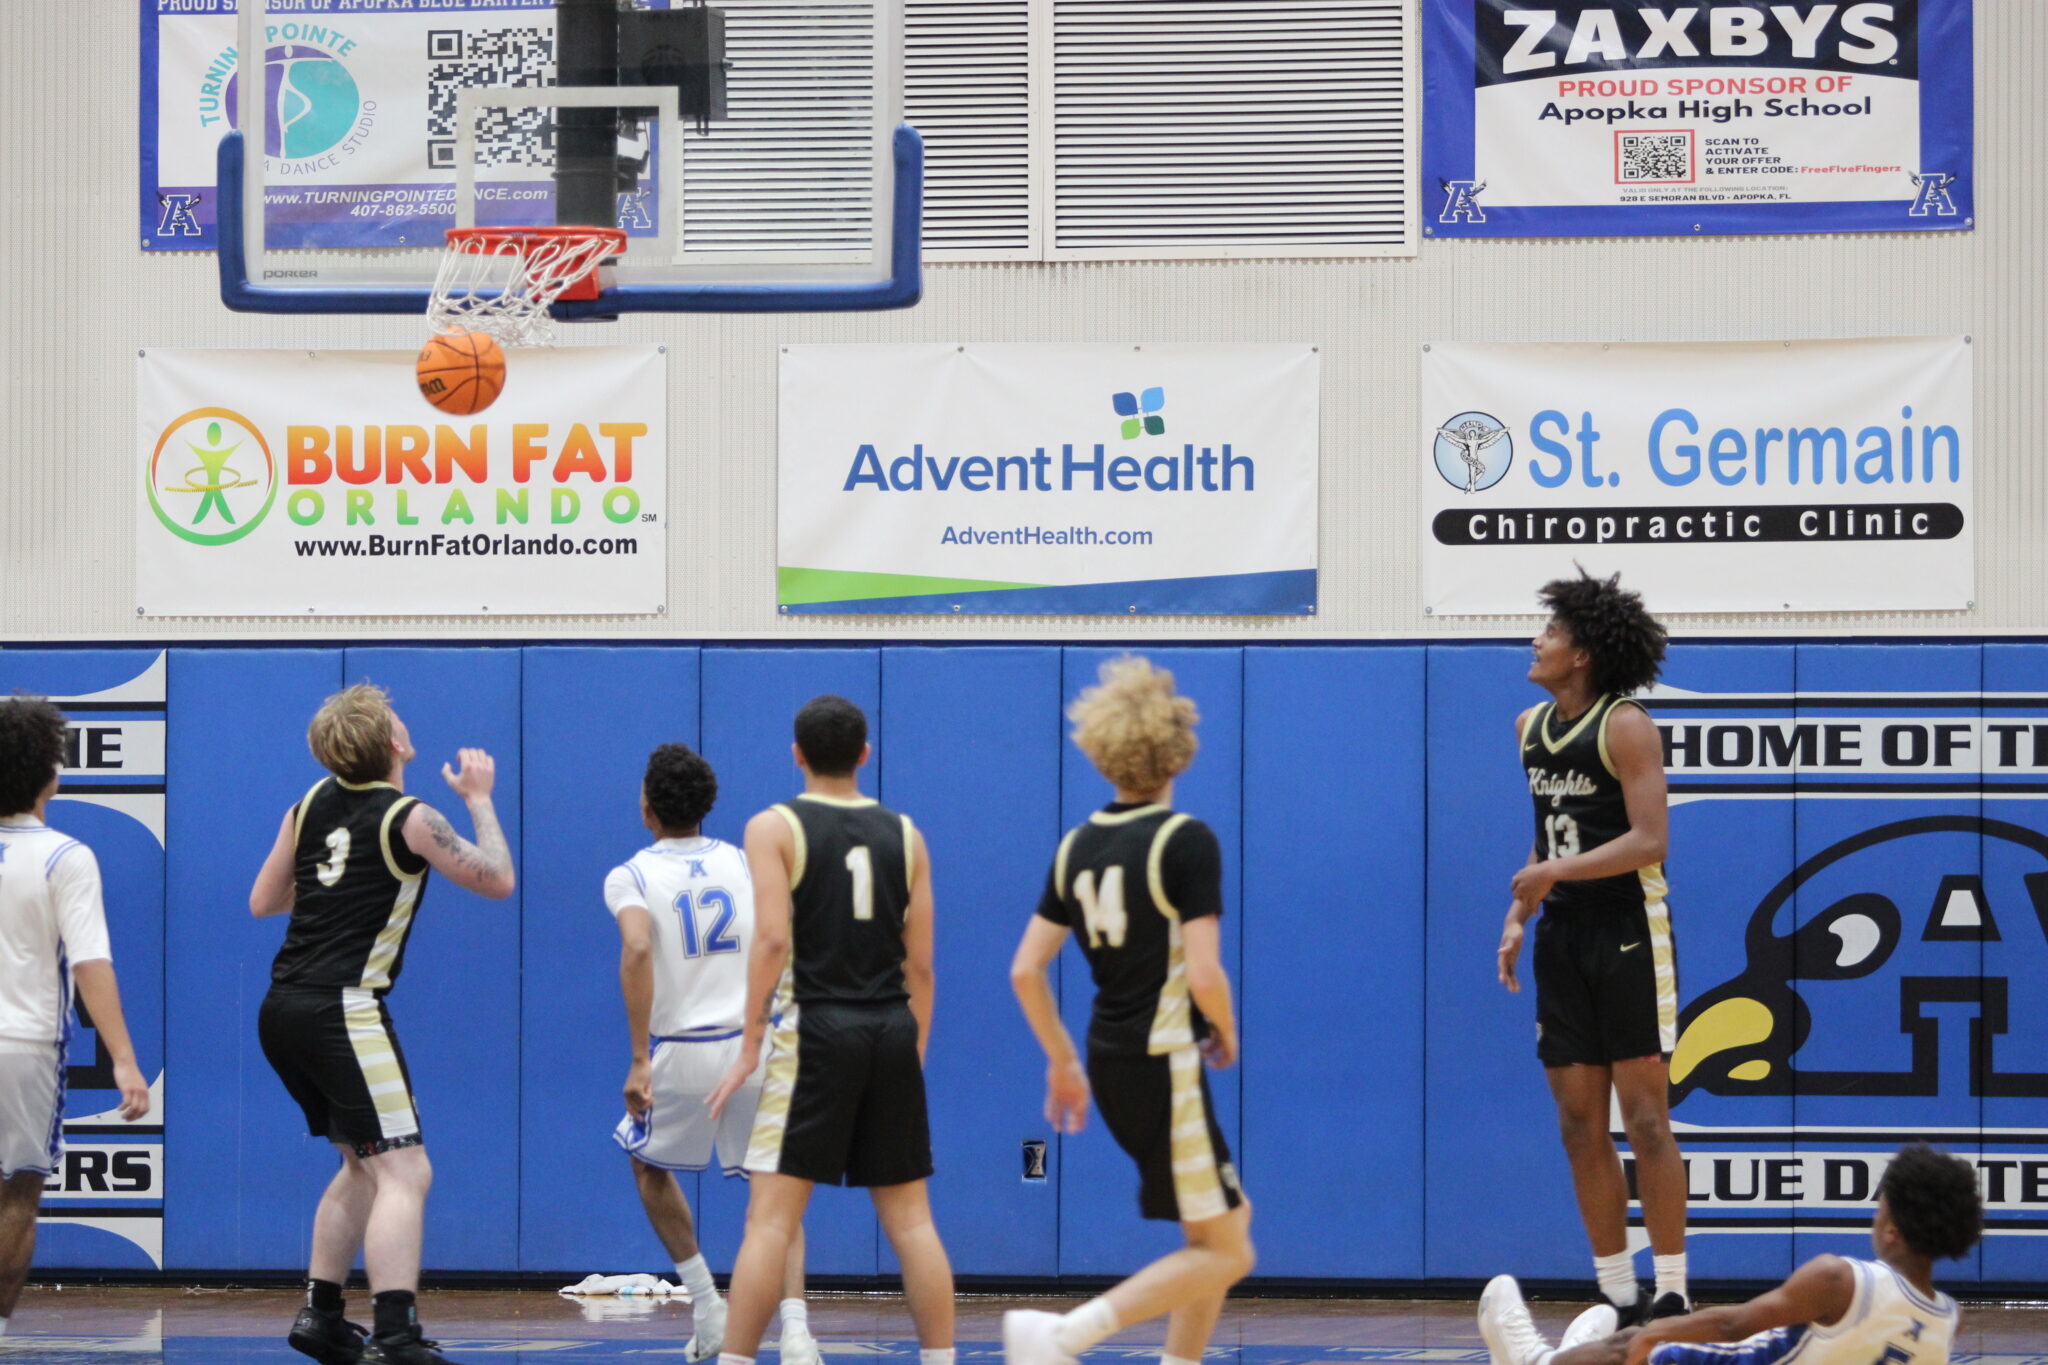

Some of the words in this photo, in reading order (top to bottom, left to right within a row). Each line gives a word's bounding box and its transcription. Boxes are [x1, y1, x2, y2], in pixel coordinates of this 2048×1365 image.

[200, 46, 239, 128] TURNIN
[265, 23, 357, 57] POINTE
[1558, 79, 1659, 98] PROUD
[1666, 76, 1808, 95] SPONSOR
[1815, 75, 1853, 93] OF
[1539, 101, 1667, 125] Apopka
[1678, 98, 1752, 124] High
[1764, 96, 1871, 118] School
[280, 154, 340, 175] DANCE
[342, 100, 377, 155] STUDIO
[1705, 138, 1739, 146] SCAN
[1740, 138, 1759, 146] TO
[1705, 147, 1769, 155] ACTIVATE
[1705, 157, 1738, 165] YOUR
[1705, 167, 1714, 175] &
[1718, 166, 1758, 174] ENTER
[1761, 166, 1798, 174] CODE:
[1801, 165, 1901, 175] FreeFiveFingerz
[351, 203, 457, 217] 407-862-5500
[286, 424, 488, 485] BURN
[512, 422, 648, 484] FAT
[1528, 409, 1620, 489] St.
[1648, 404, 1960, 487] Germain
[287, 486, 641, 526] ORLANDO
[1468, 510, 1762, 543] Chiropractic
[1800, 508, 1930, 536] Clinic
[295, 533, 638, 557] www.BurnFatOrlando.com
[941, 526, 1153, 546] AdventHealth.com
[1663, 724, 1862, 768] HOME
[1881, 724, 1972, 768] OF
[1528, 767, 1597, 807] Knights
[316, 826, 351, 887] 3
[1545, 814, 1580, 861] 13
[845, 846, 874, 920] 1
[672, 887, 741, 959] 12
[1072, 865, 1128, 948] 14
[1623, 1158, 1805, 1201] LUE
